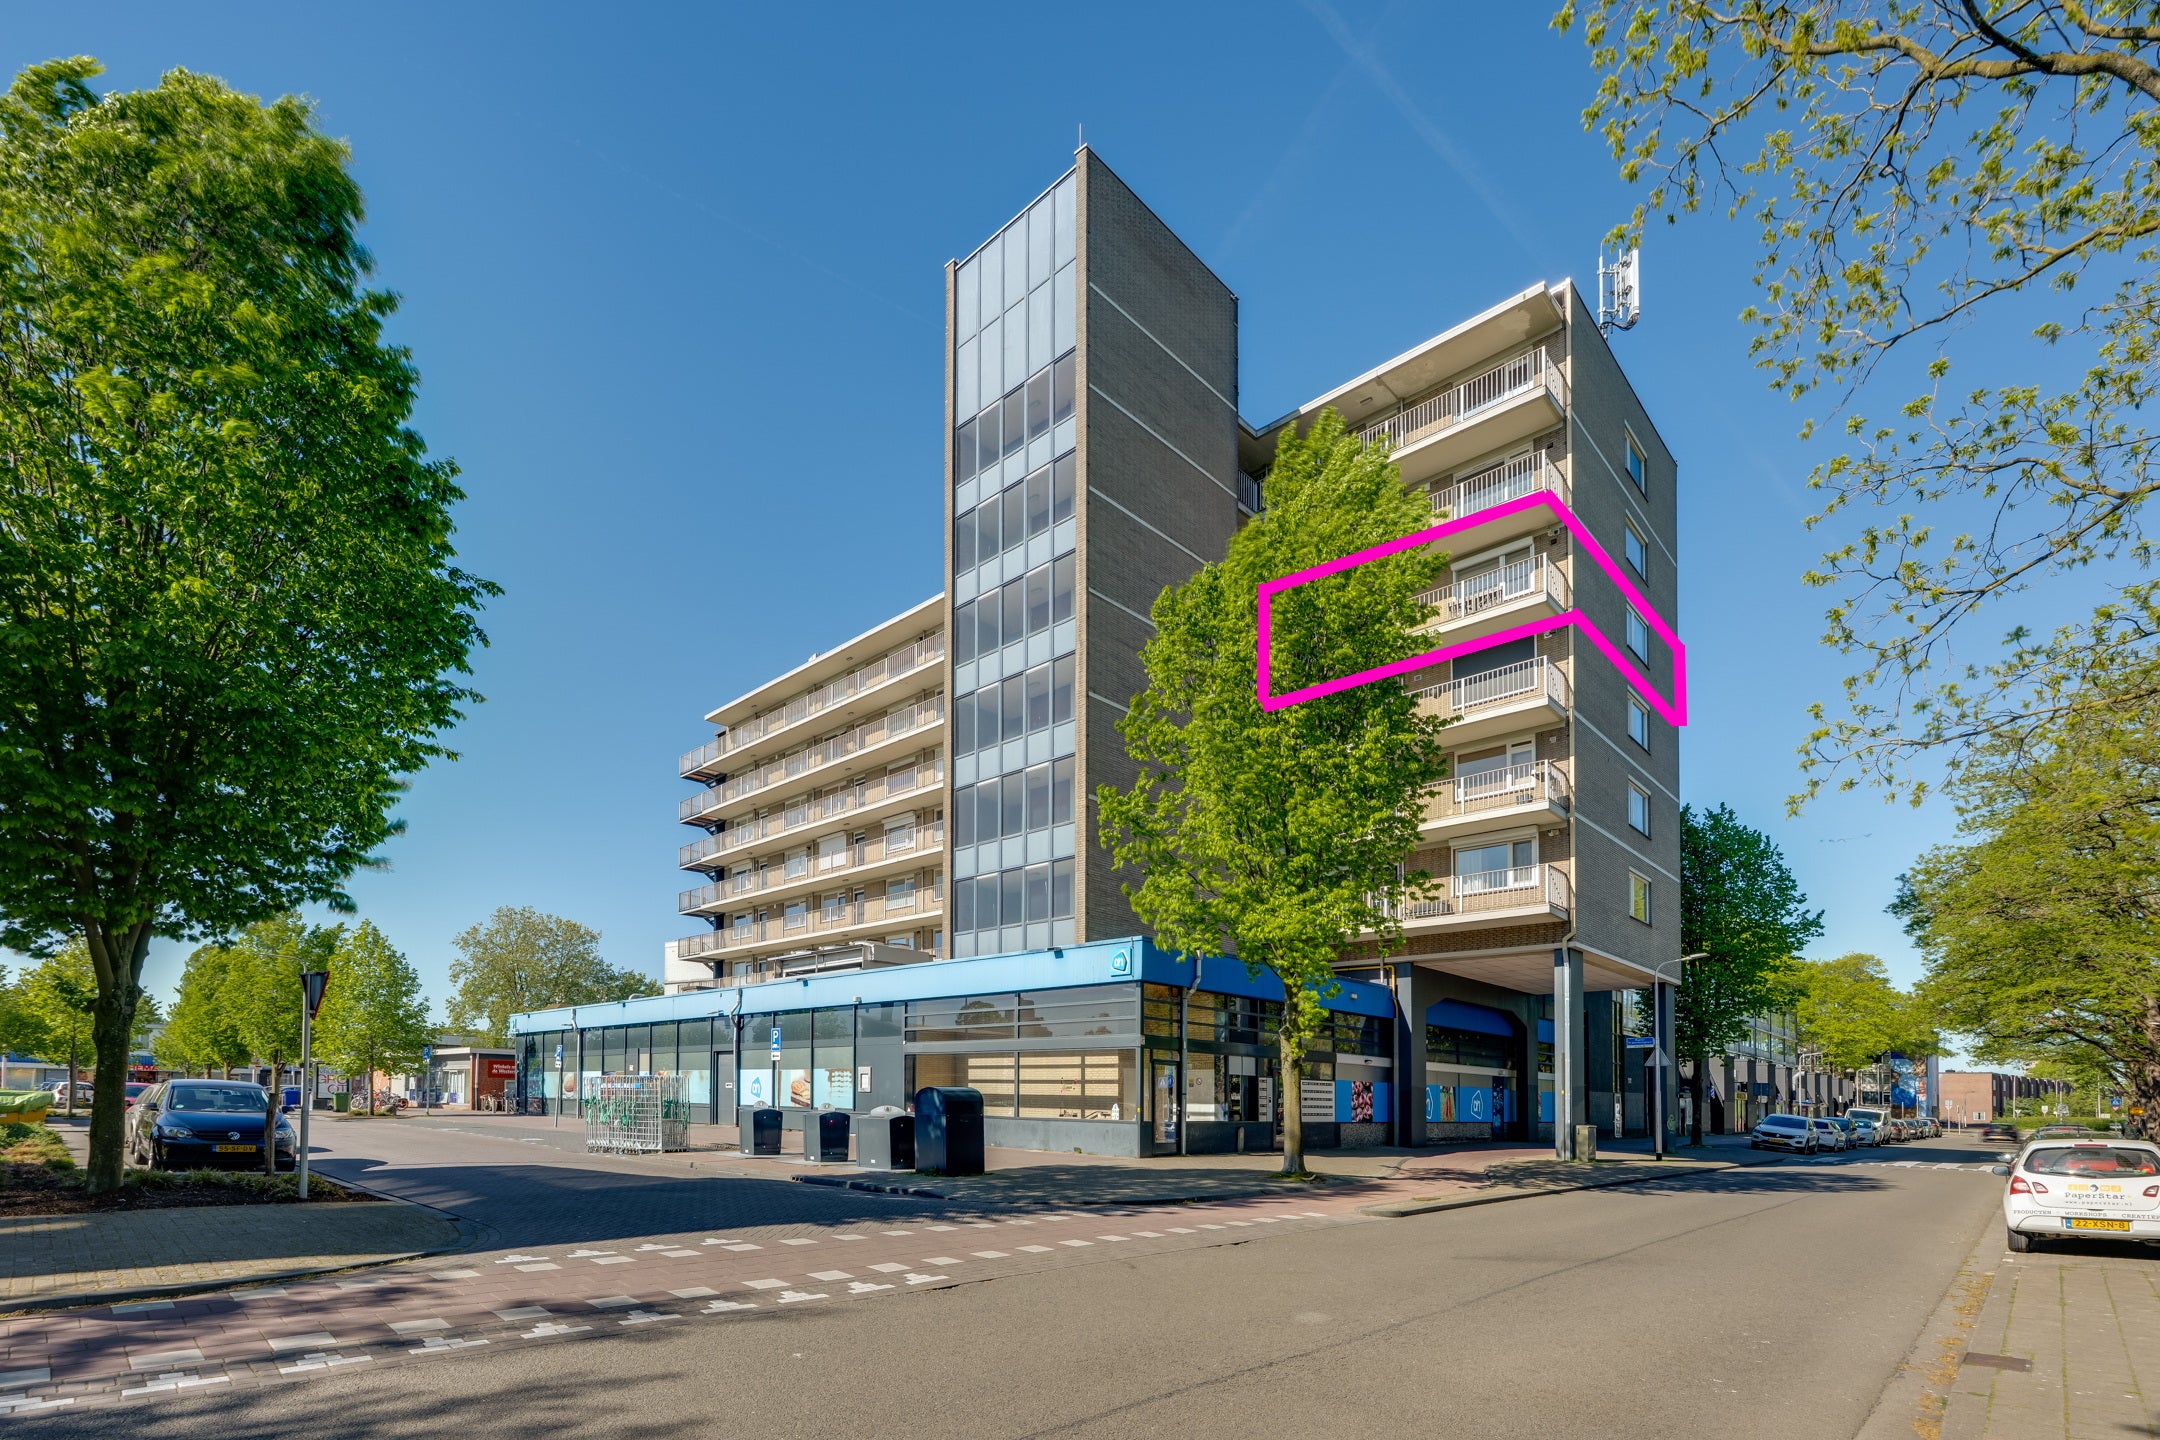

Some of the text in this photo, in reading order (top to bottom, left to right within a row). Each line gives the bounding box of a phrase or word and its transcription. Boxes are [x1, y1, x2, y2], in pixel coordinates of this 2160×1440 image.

[773, 1031, 778, 1042] P
[2065, 1192, 2125, 1200] PaperStar
[2075, 1219, 2126, 1230] 22-XSN-8
